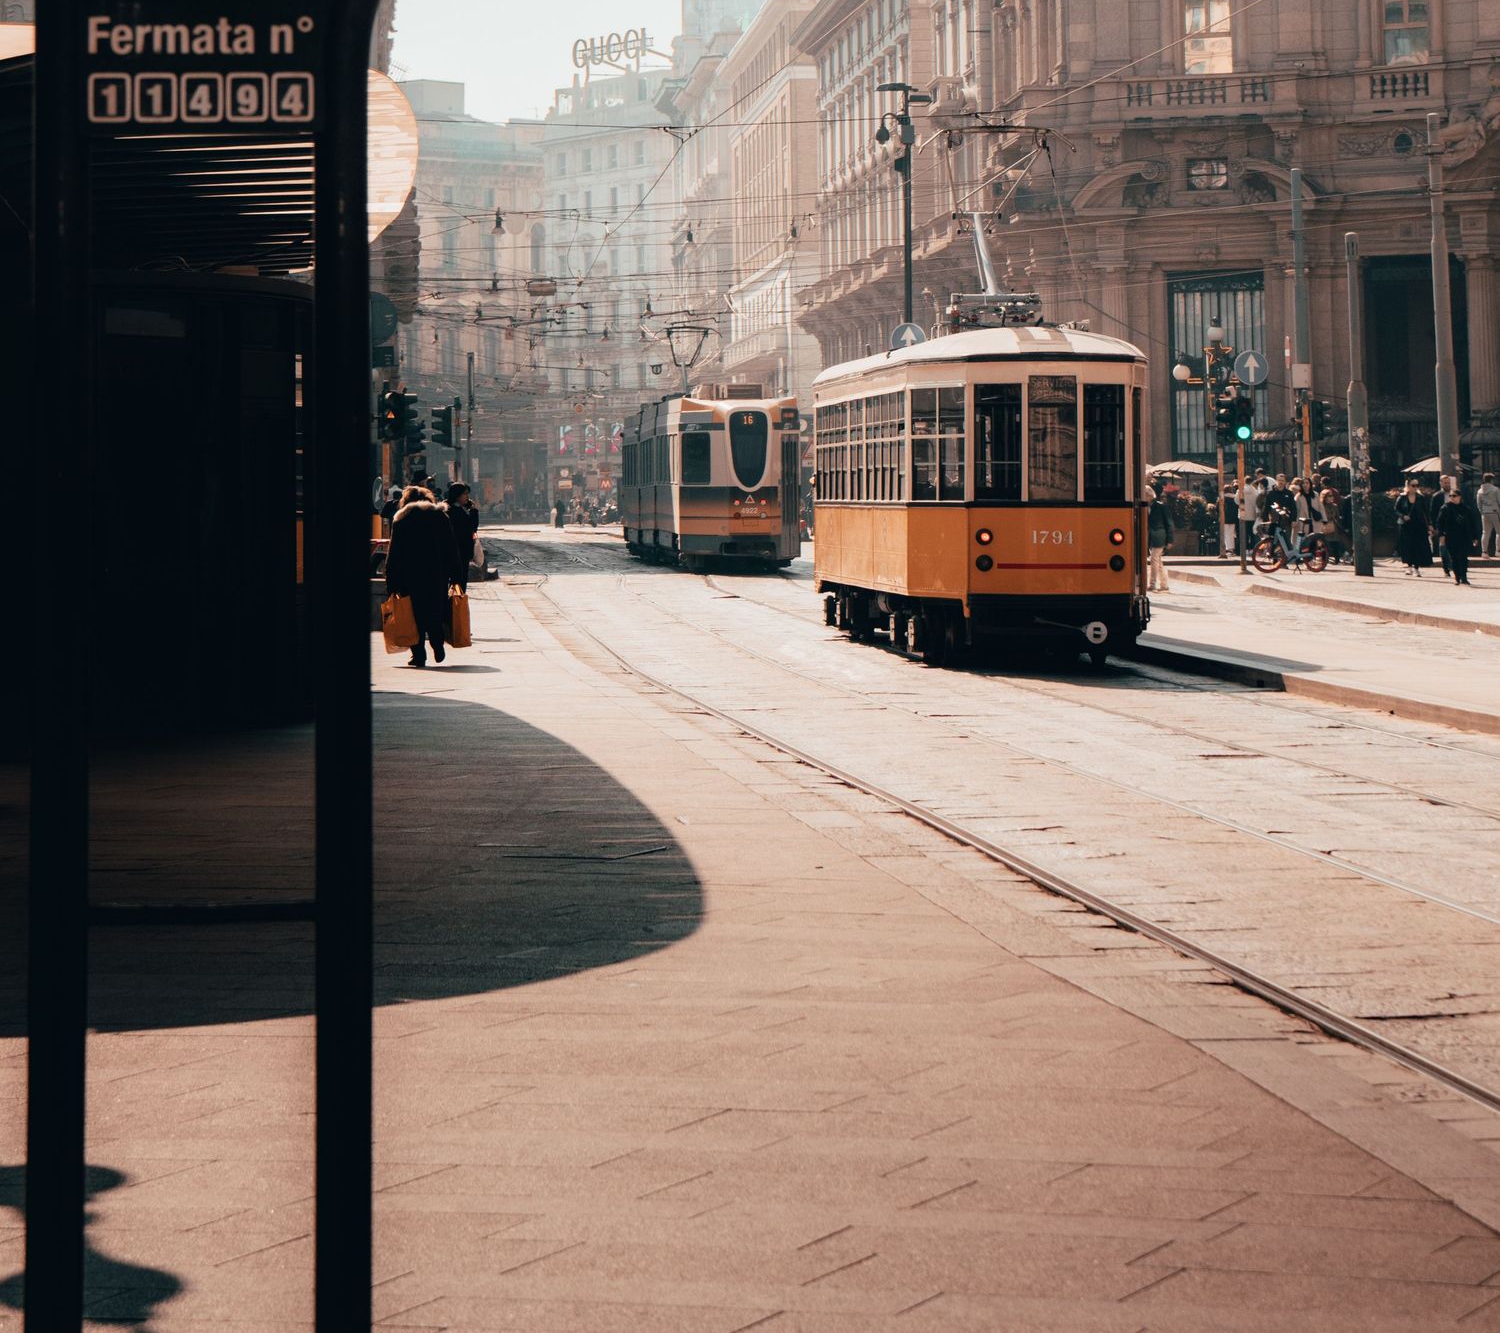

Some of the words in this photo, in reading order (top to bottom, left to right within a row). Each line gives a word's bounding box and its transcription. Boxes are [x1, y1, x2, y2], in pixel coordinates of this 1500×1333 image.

[87, 16, 255, 55] Fermata
[270, 16, 314, 54] n°
[573, 27, 646, 68] GUCCI
[101, 84, 304, 115] 11494
[743, 415, 753, 425] 16
[741, 507, 758, 515] 4922
[1032, 530, 1073, 545] 1794
